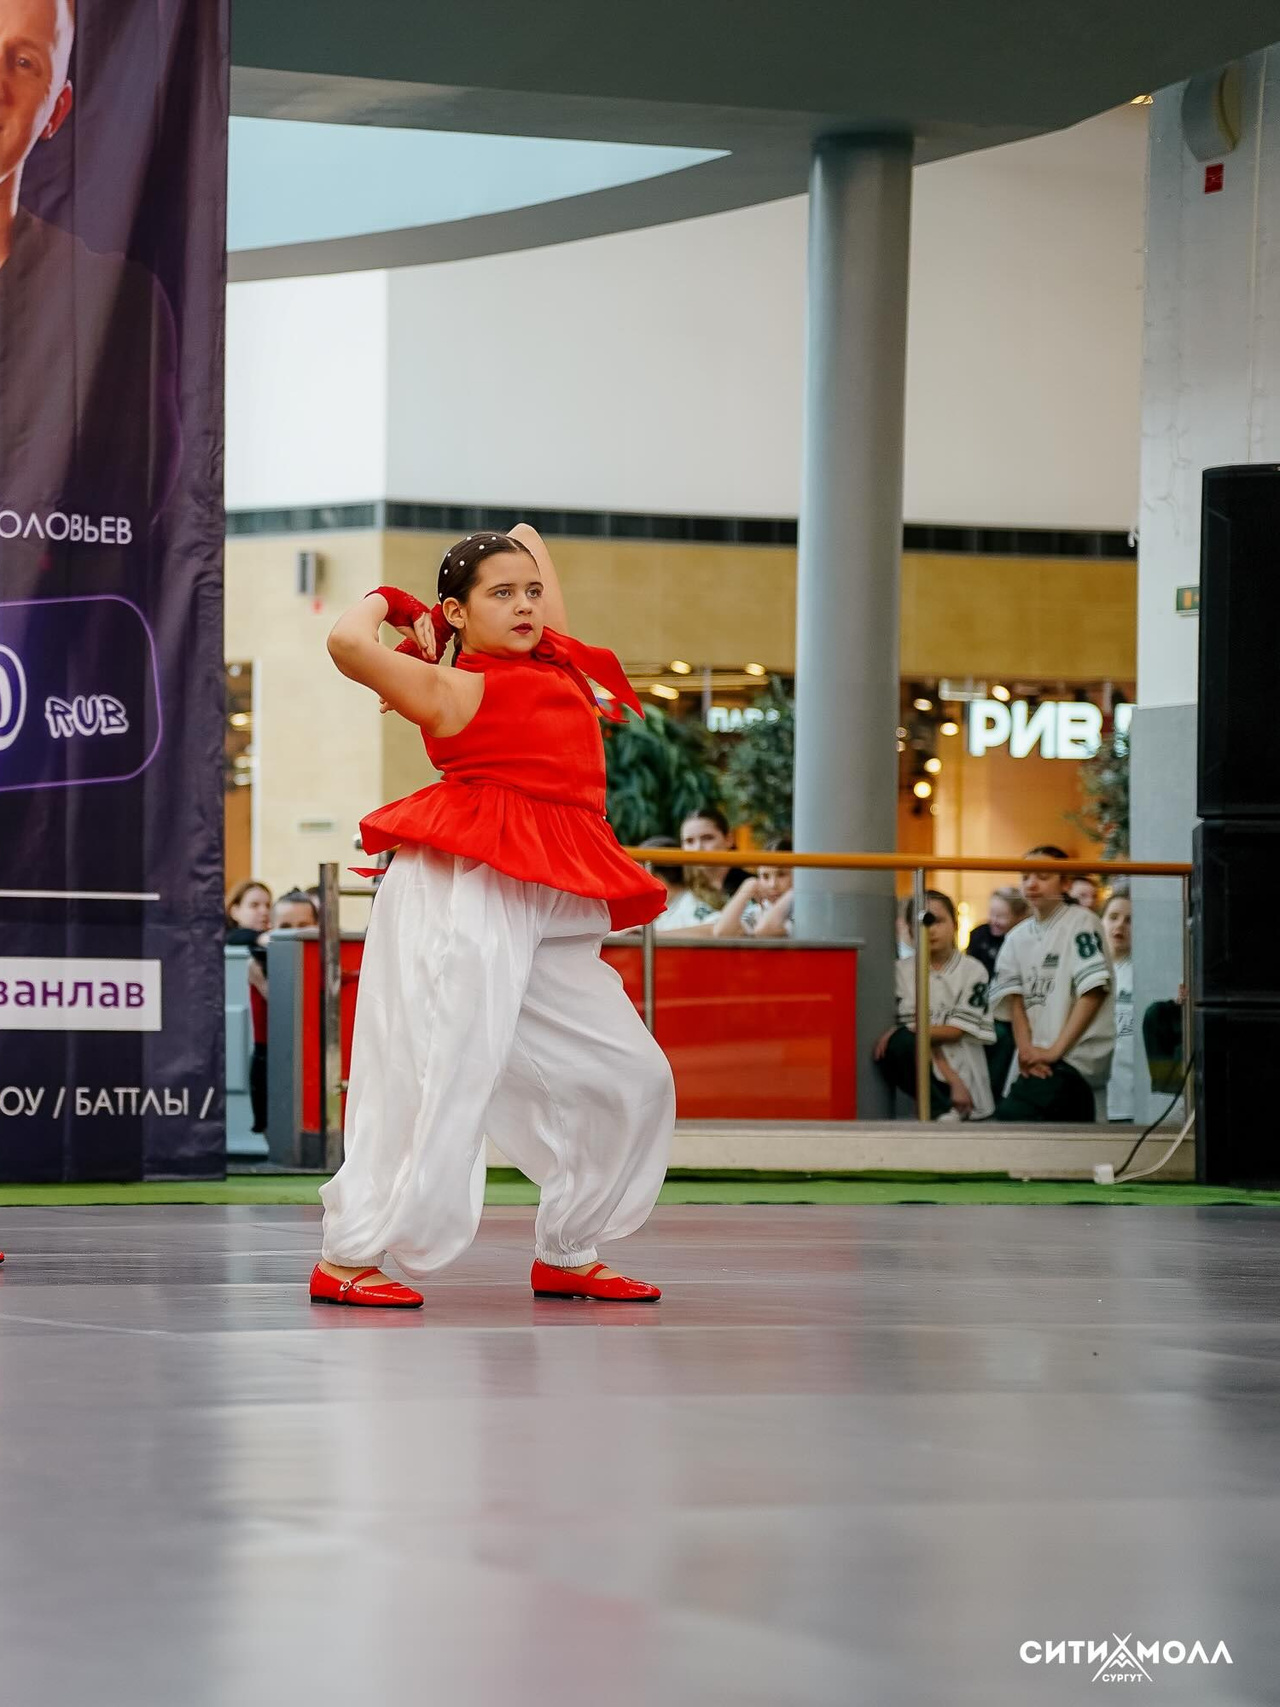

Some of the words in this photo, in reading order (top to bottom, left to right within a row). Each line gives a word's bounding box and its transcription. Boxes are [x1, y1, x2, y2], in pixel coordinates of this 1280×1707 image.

[44, 694, 130, 739] RUB
[969, 699, 1104, 760] РИВ
[75, 1086, 189, 1117] БАТТЛЫ
